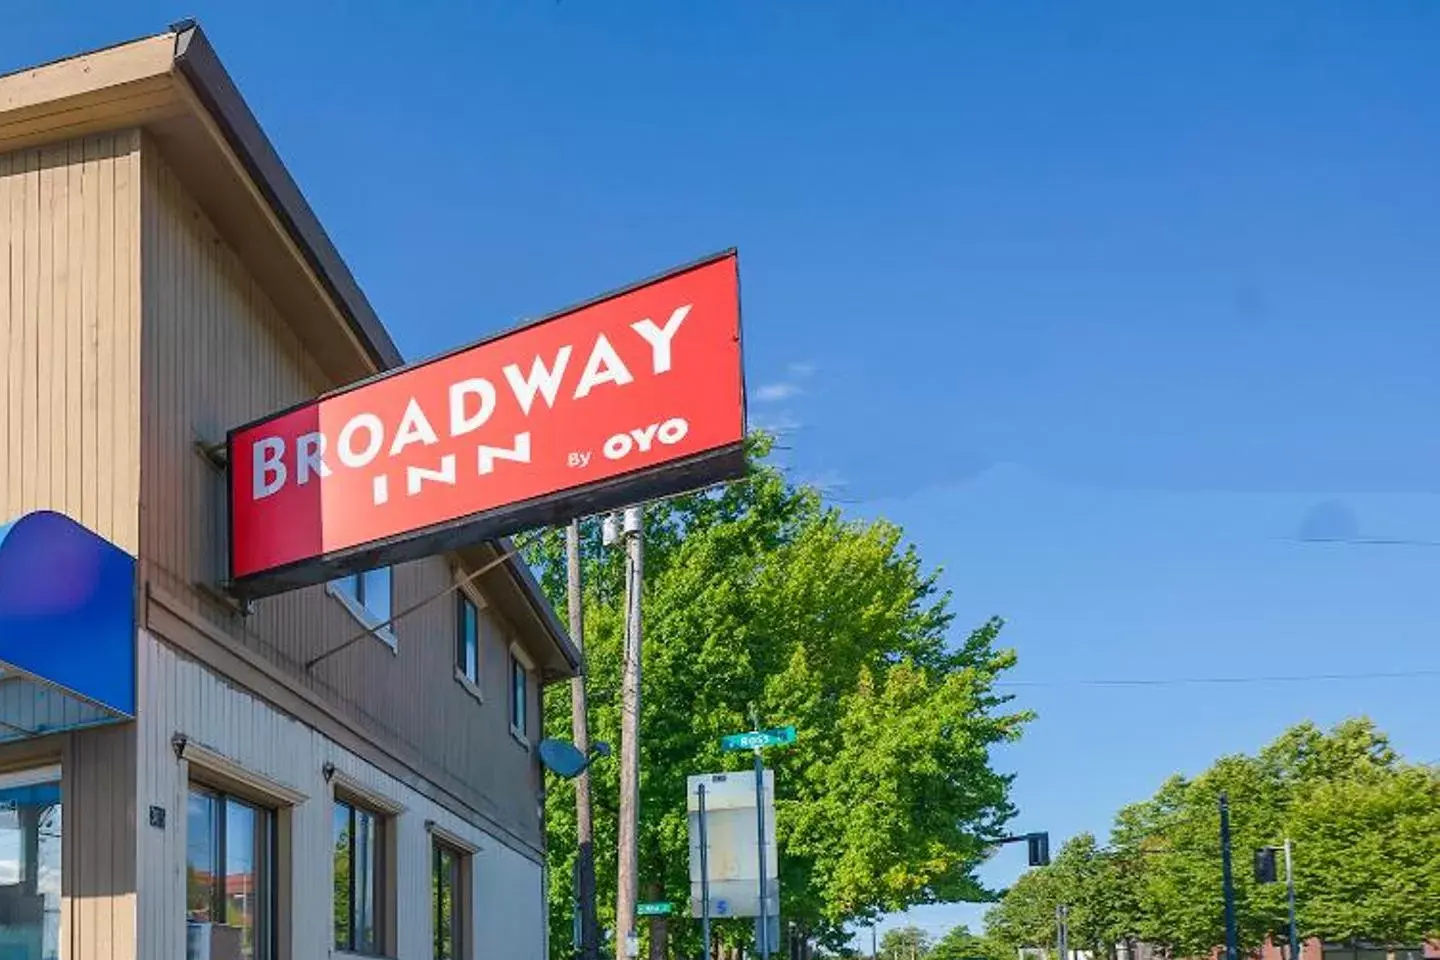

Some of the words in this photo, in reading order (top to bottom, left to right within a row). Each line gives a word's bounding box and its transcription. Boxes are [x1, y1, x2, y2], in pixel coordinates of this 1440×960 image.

[252, 304, 693, 500] BROADWAY
[372, 430, 532, 507] INN
[566, 449, 591, 469] By
[602, 417, 689, 461] OYO
